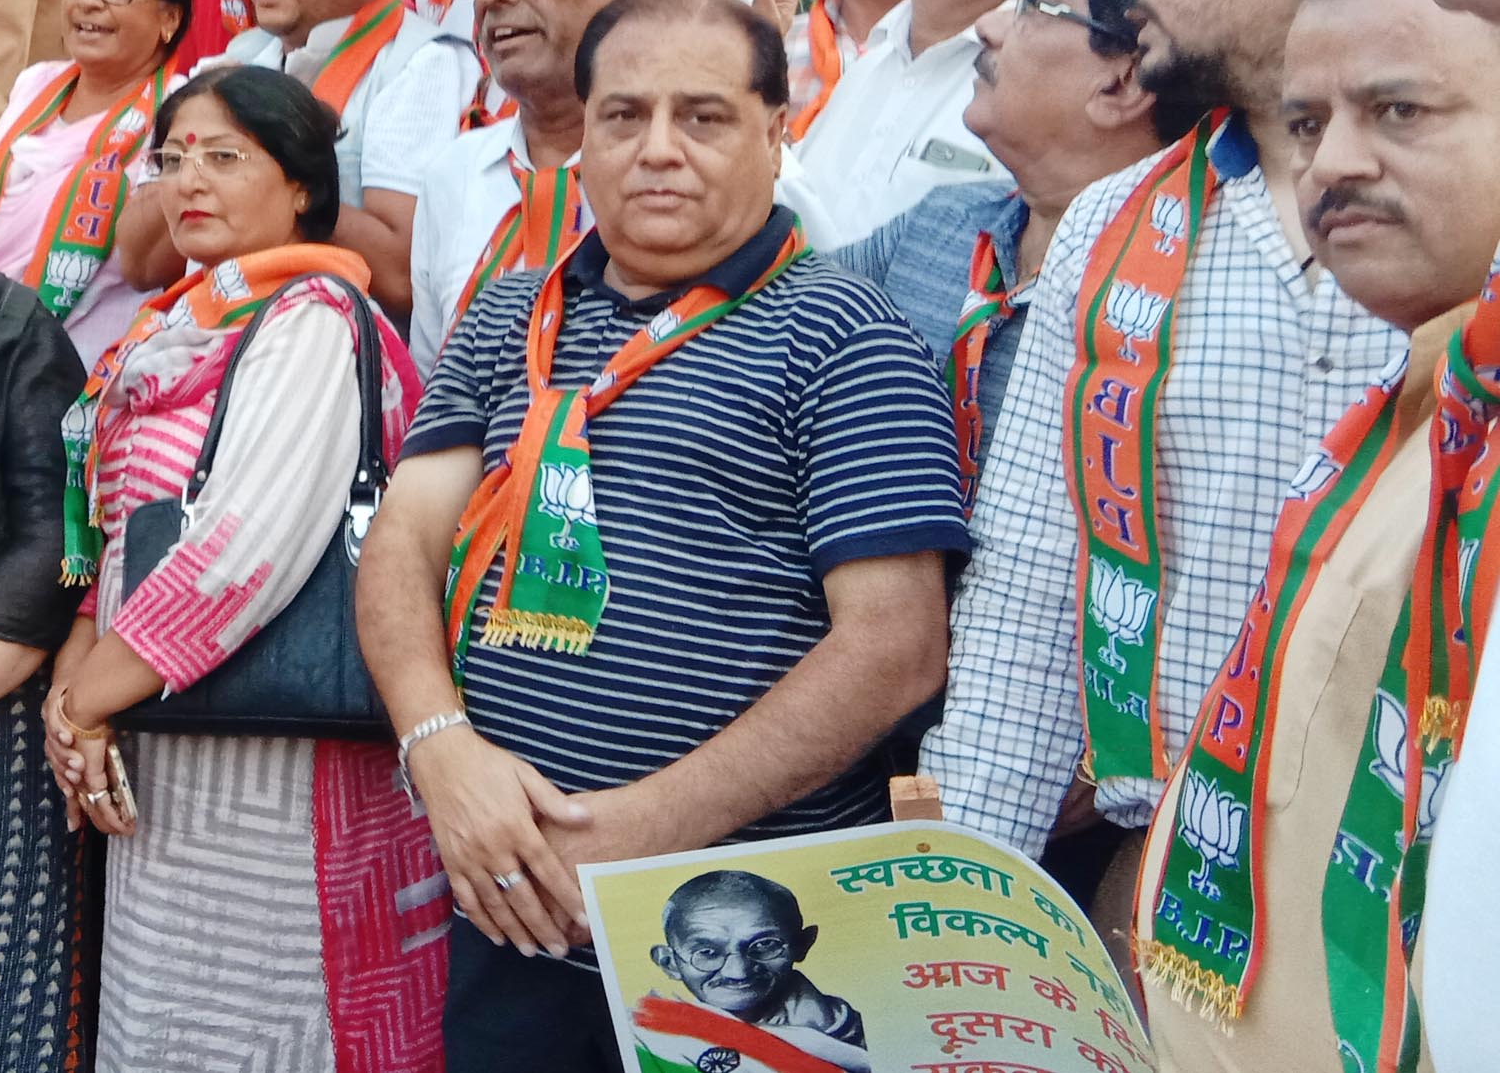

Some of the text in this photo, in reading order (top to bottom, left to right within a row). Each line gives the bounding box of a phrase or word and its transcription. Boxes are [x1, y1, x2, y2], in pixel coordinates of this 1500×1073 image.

[830, 854, 1086, 948] स्वच्छता का
[888, 901, 1049, 959] विकल्प
[902, 960, 1011, 992] आज
[1029, 975, 1078, 1012] के
[925, 1011, 1057, 1050] दूसरा
